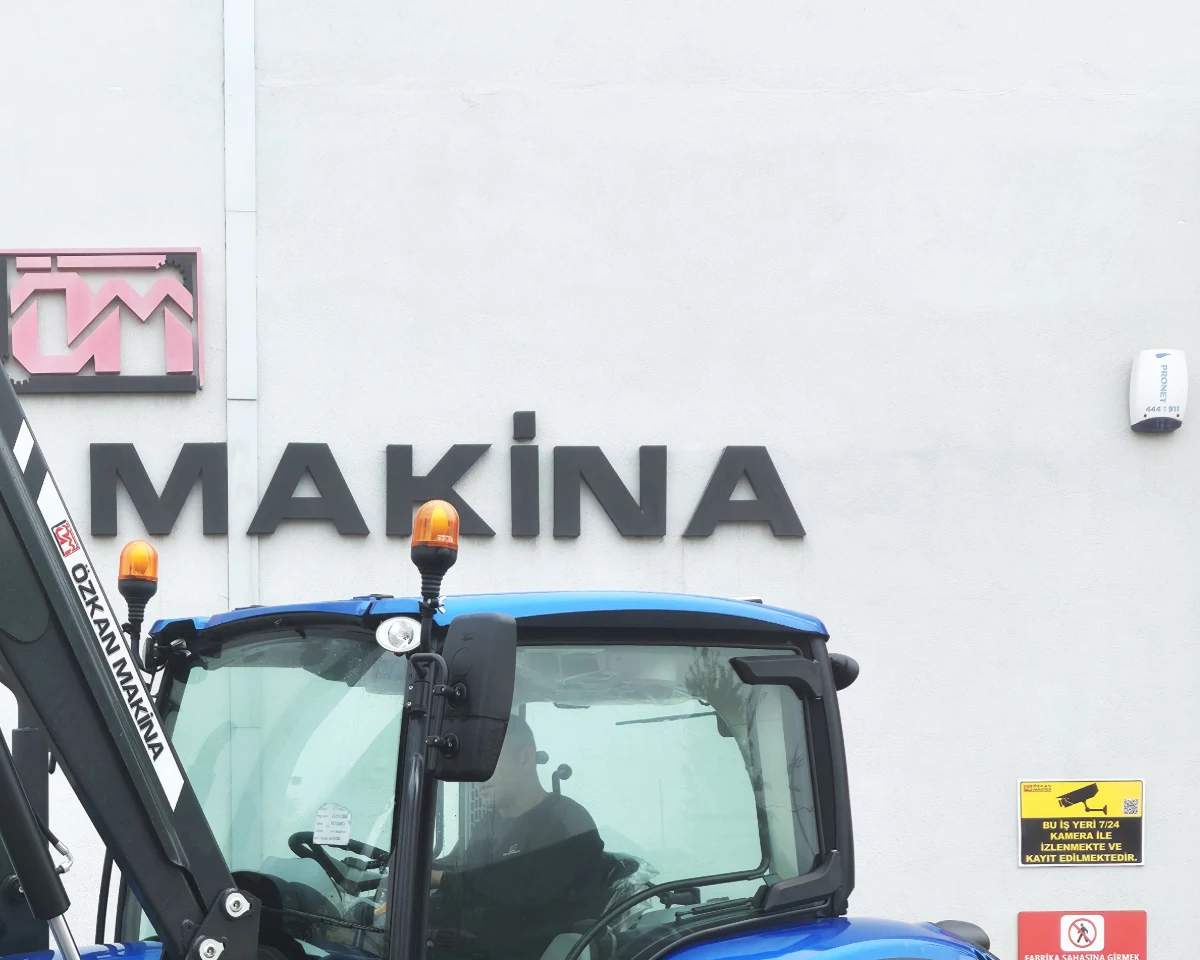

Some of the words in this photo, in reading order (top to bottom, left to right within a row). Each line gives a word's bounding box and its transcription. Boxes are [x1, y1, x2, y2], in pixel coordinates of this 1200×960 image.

[1160, 364, 1168, 403] PRONET
[89, 410, 806, 538] MAKİNA
[71, 562, 120, 656] ÖZKAN
[112, 657, 165, 761] MAKİNA
[1042, 821, 1057, 830] BU
[1060, 820, 1070, 830] İŞ
[1073, 820, 1096, 829] YERİ
[1098, 820, 1120, 828] 7/24
[1050, 832, 1094, 840] KAMERA
[1096, 830, 1112, 840] İLE
[1041, 842, 1106, 851] İZLENMEKTE
[1026, 854, 1056, 862] KAYIT
[1060, 852, 1138, 862] EDİLMEKTEDİR.
[1108, 952, 1140, 960] GİRMEK
